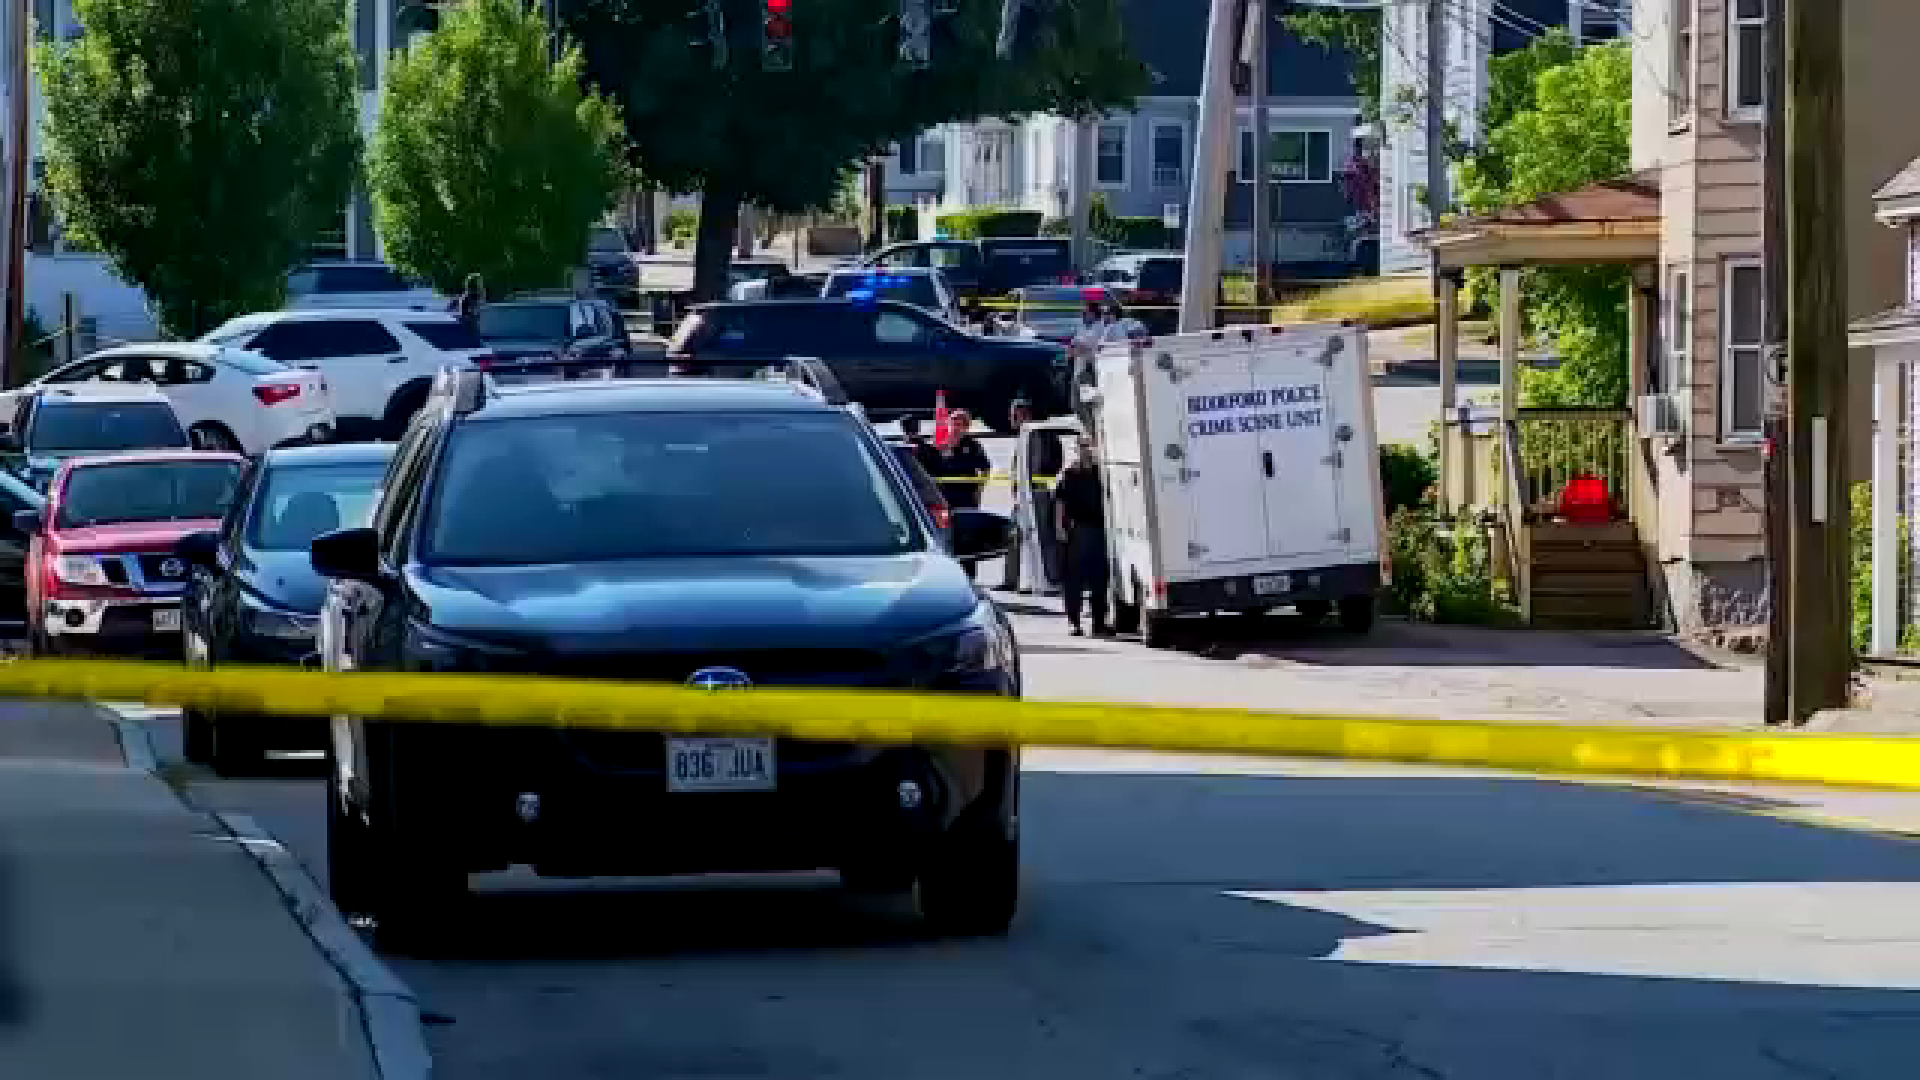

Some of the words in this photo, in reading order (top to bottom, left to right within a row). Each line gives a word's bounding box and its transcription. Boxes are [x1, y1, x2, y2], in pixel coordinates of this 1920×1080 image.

[1272, 385, 1321, 405] POLICE
[1188, 418, 1235, 438] CRIME
[1287, 408, 1321, 428] UNIT
